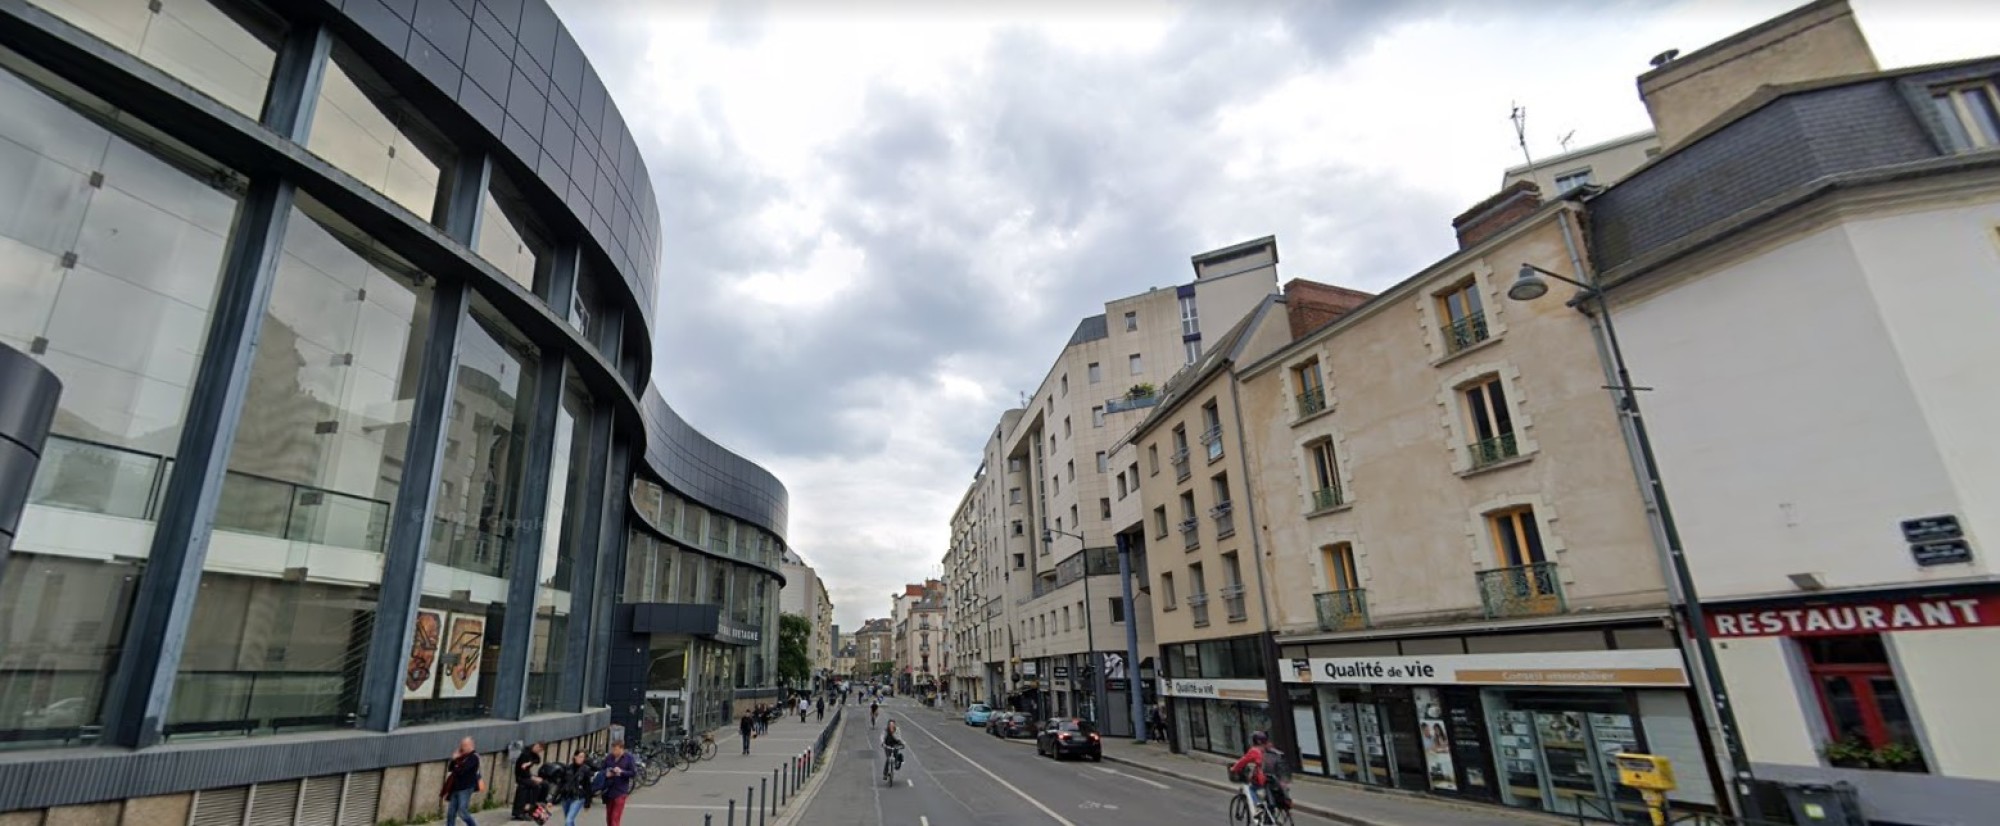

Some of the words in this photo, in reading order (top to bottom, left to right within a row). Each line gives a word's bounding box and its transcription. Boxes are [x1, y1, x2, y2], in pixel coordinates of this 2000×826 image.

[1715, 599, 1981, 636] RESTAURANT
[1324, 661, 1383, 679] Qualité
[1387, 666, 1402, 677] de
[1404, 661, 1434, 677] vie
